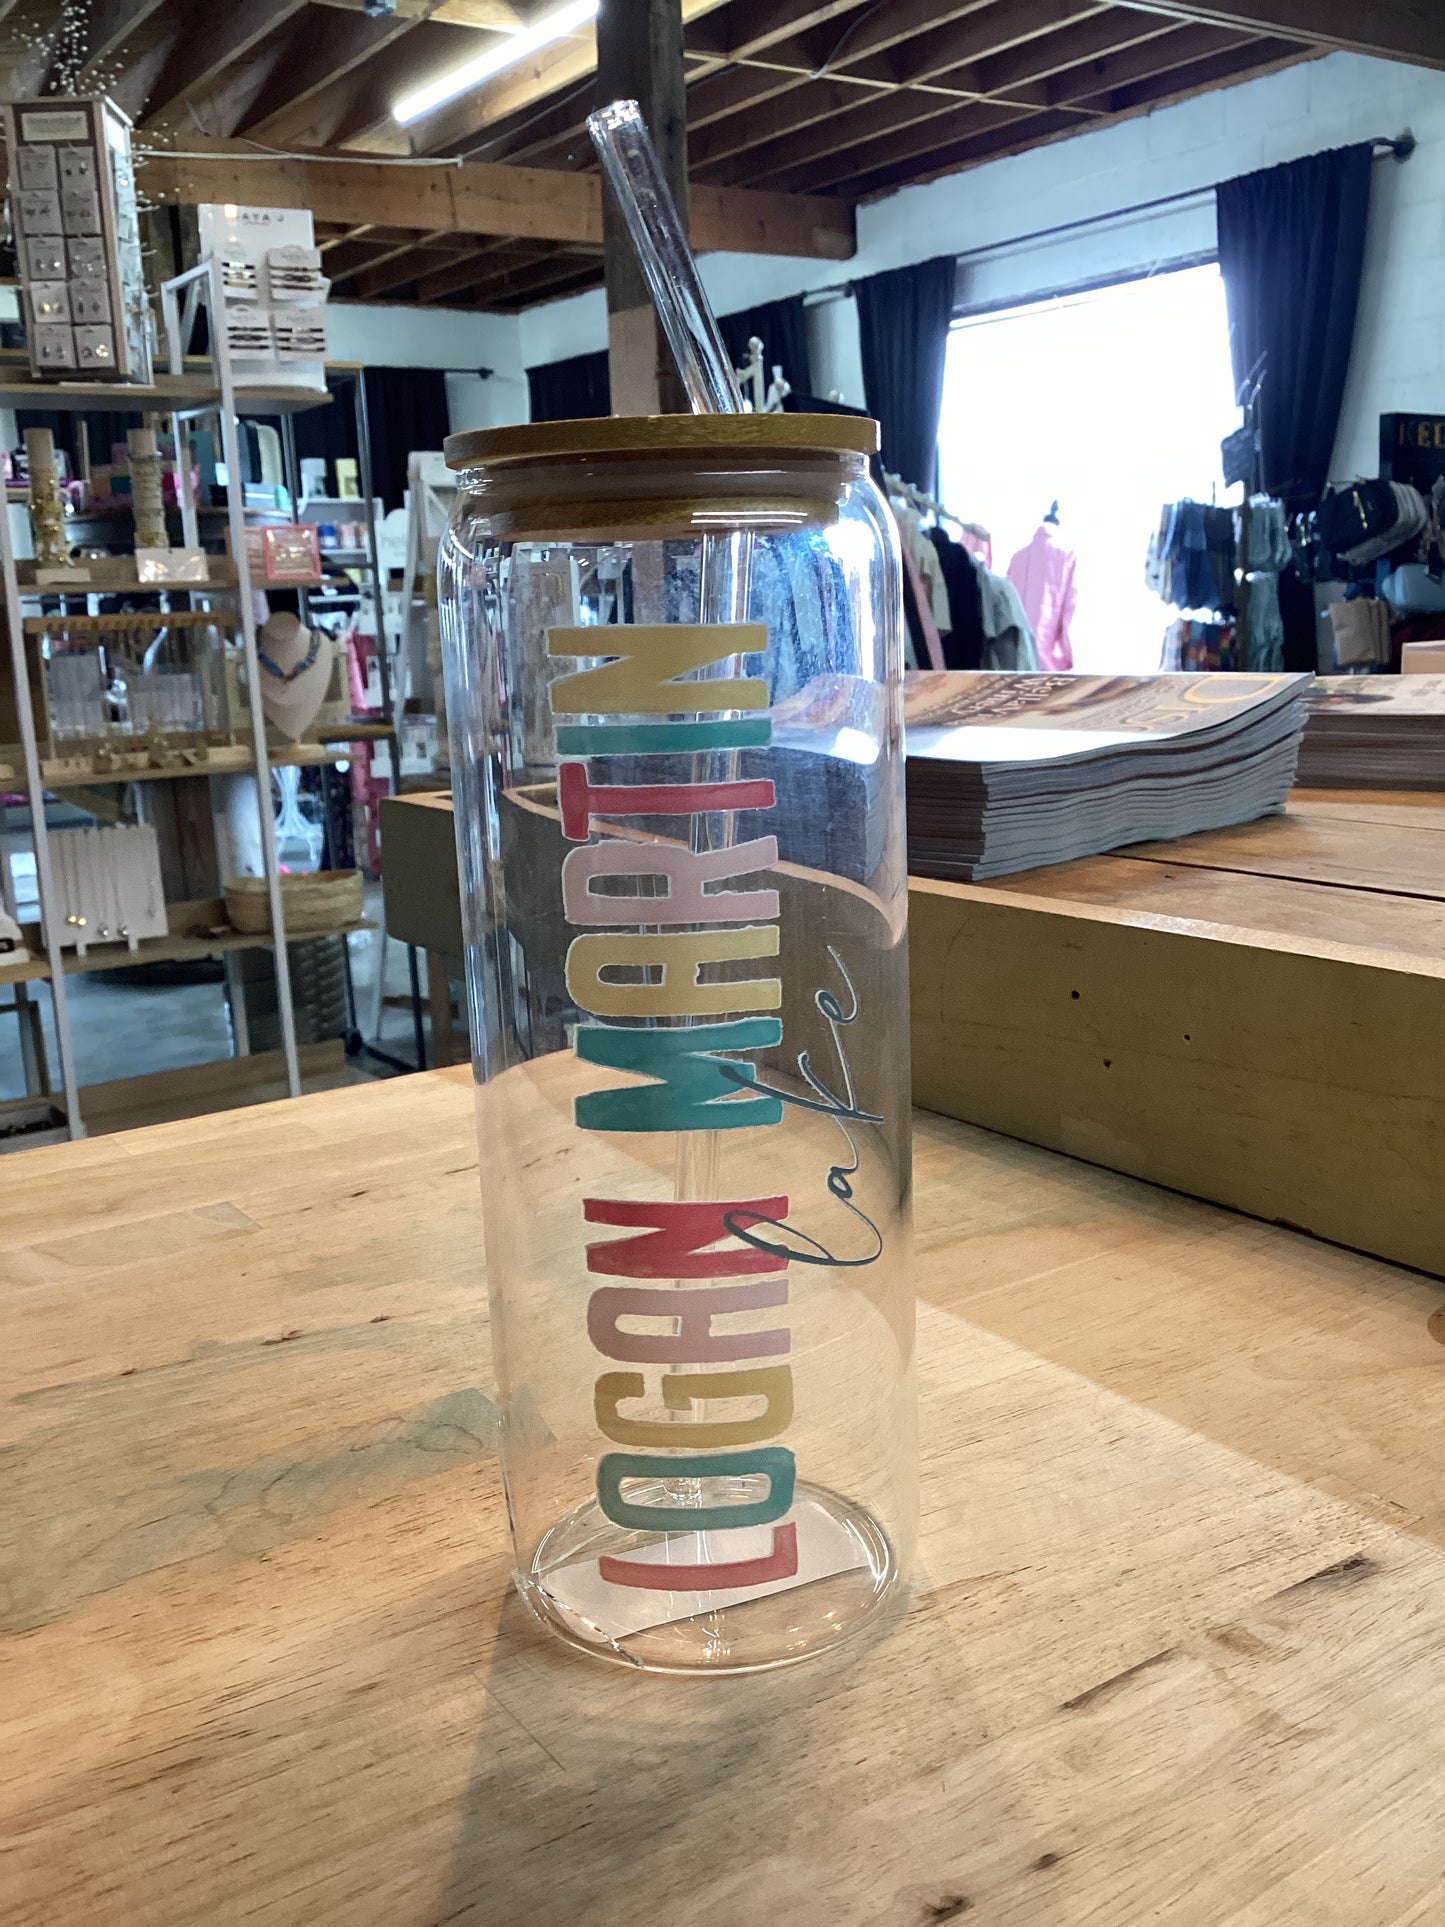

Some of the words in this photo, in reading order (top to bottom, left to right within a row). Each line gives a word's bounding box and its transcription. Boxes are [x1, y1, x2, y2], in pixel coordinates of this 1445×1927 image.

[545, 623, 784, 1132] MARTIN
[719, 945, 885, 1266] Lake
[582, 1195, 799, 1592] LOGAN
